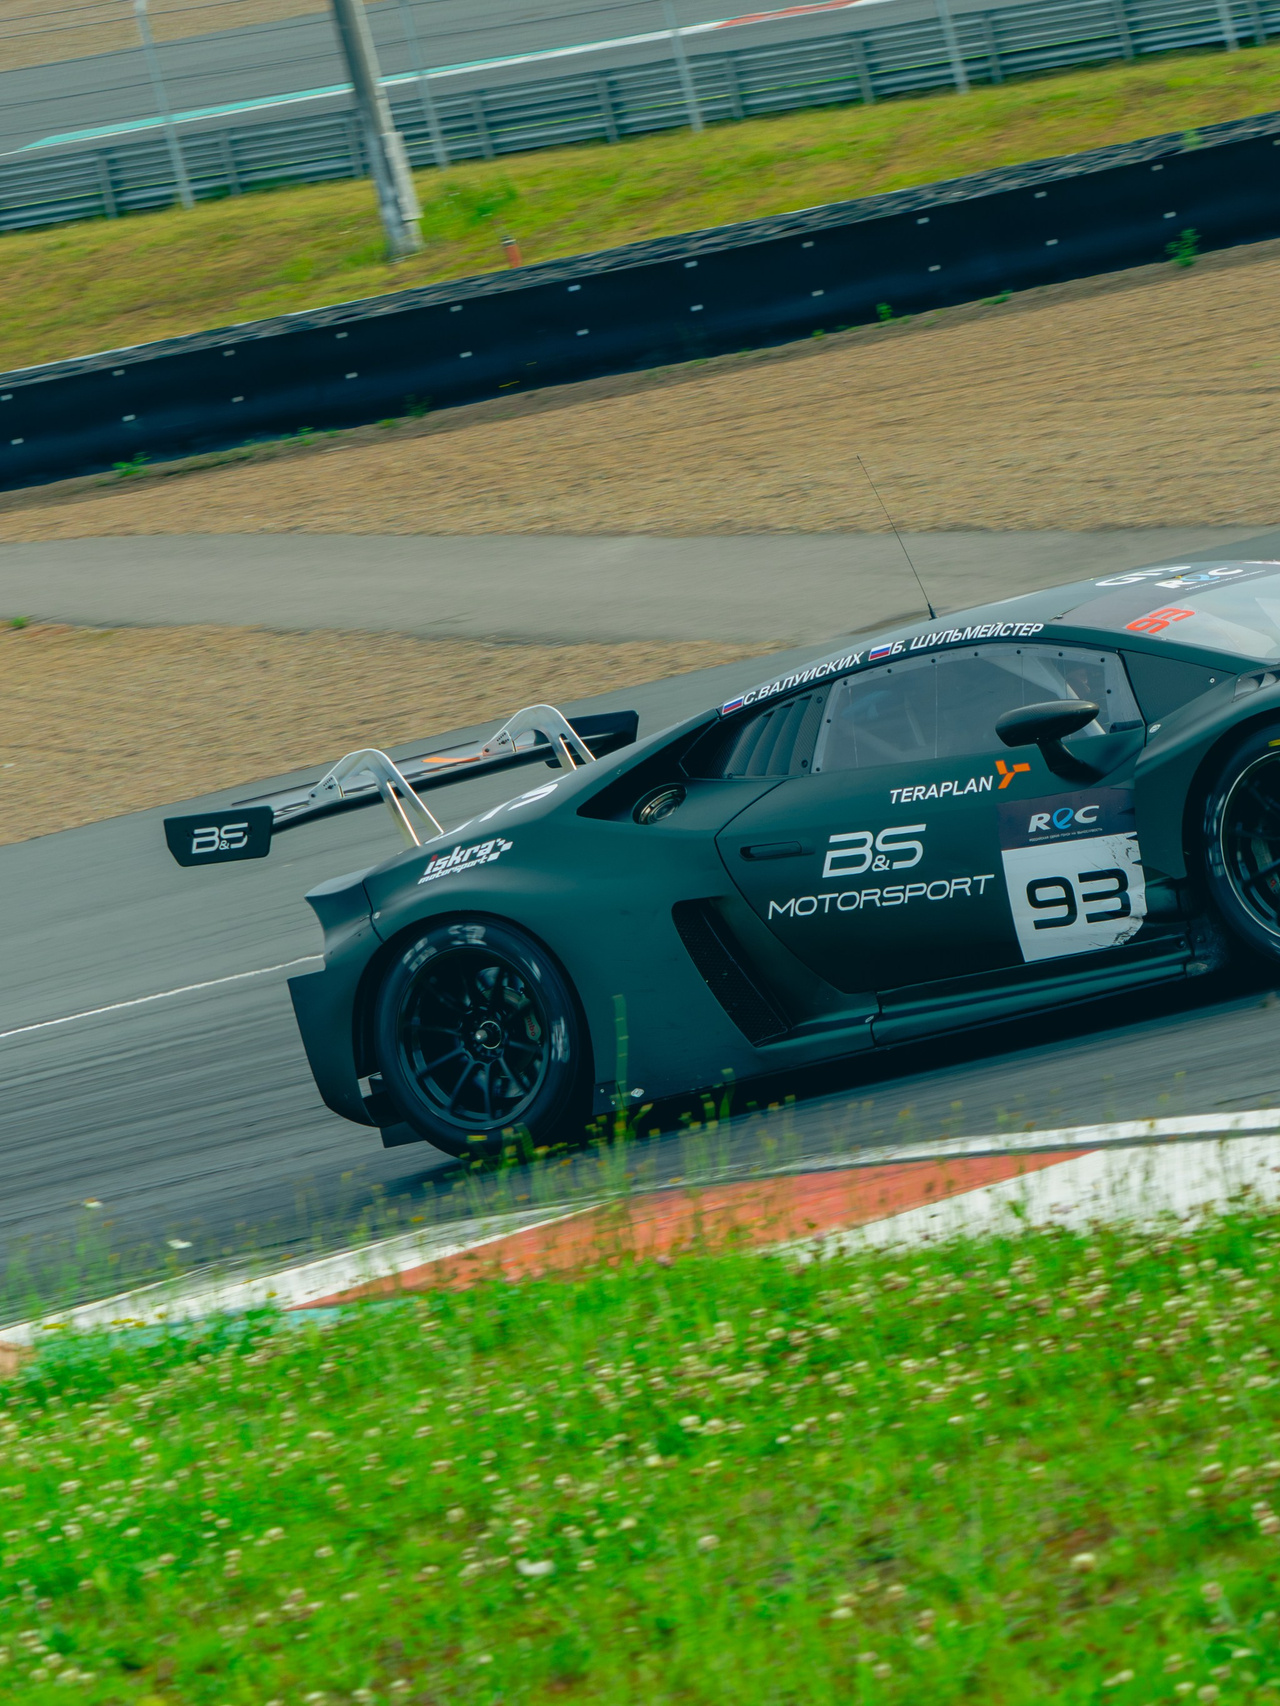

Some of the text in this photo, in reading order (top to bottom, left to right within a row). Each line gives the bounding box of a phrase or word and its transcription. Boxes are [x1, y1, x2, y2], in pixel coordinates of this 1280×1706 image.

[910, 622, 1043, 650] ШУЛЬМЕЙСТЕР
[1126, 607, 1195, 634] 93
[890, 775, 993, 804] TERAPLAN
[192, 822, 248, 854] B&S
[822, 824, 926, 878] B&S
[417, 854, 487, 885] motorsport
[424, 840, 496, 875] iskra
[768, 874, 994, 920] MOTORSPORT
[1026, 868, 1131, 930] 93
